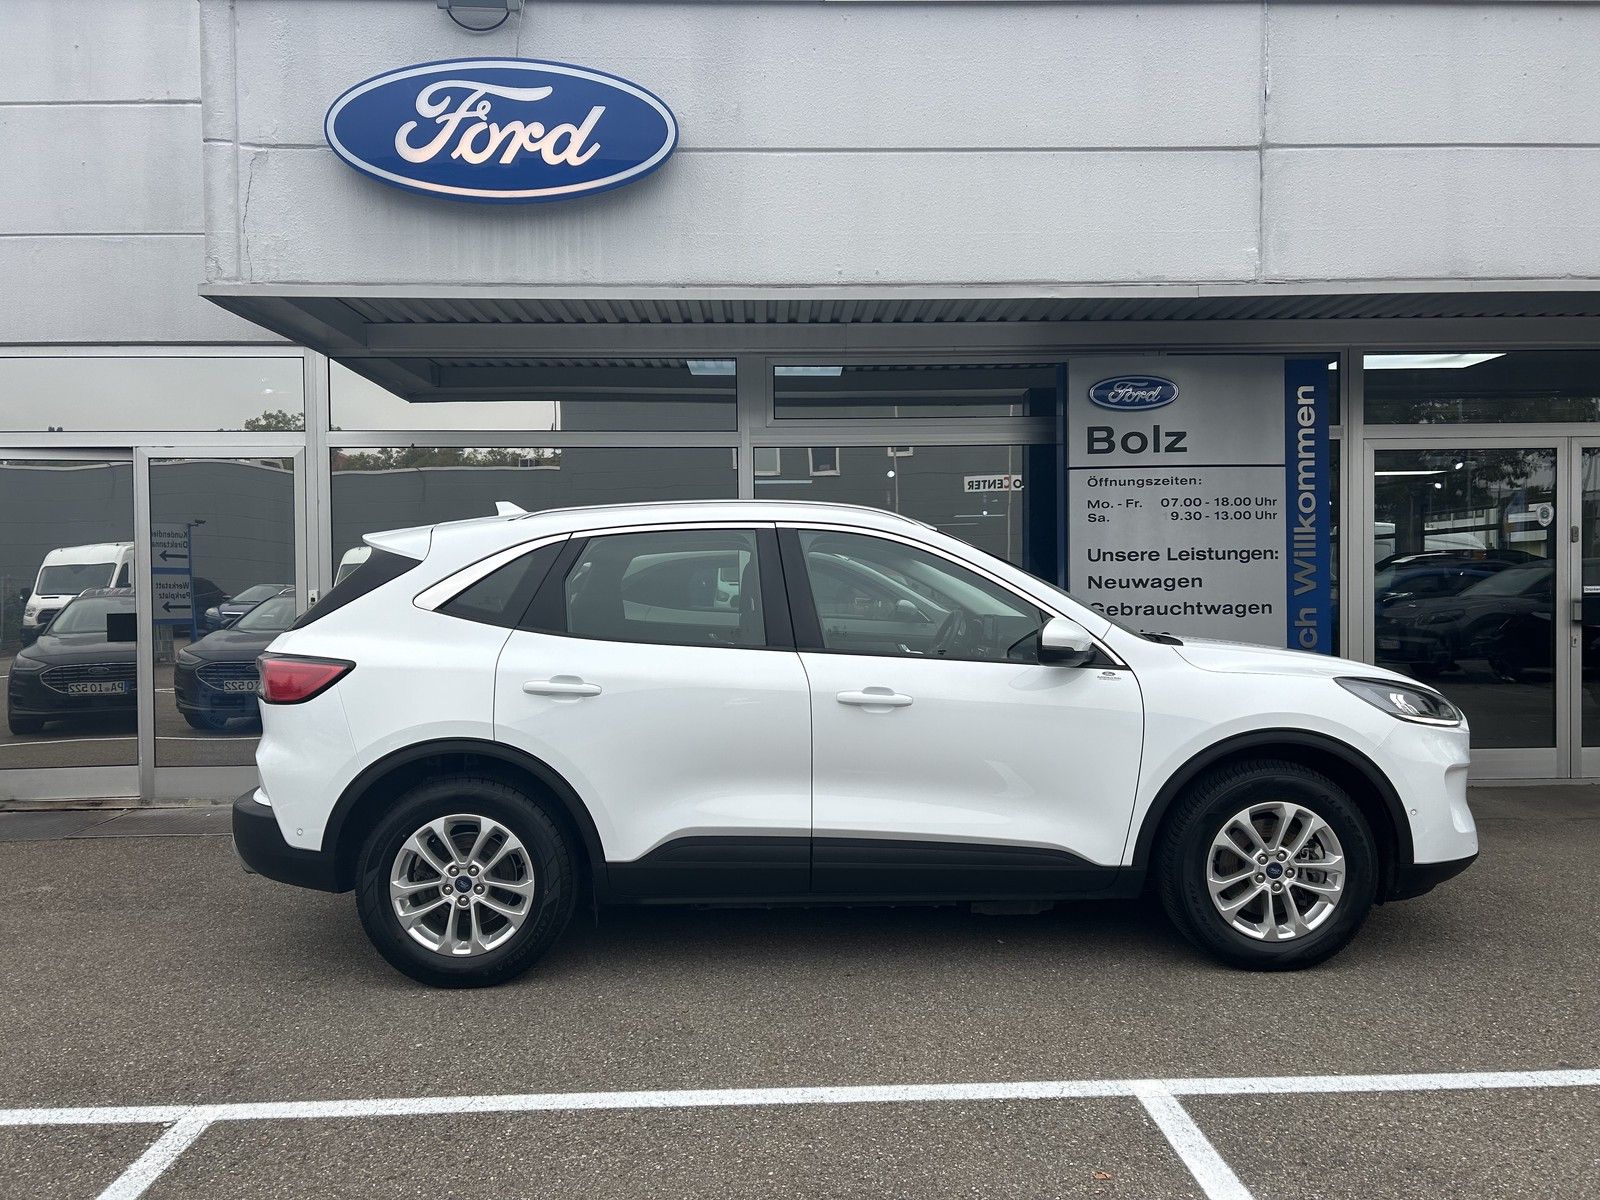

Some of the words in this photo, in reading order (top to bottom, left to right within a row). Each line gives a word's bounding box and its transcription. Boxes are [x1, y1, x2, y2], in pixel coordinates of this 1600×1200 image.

[394, 79, 606, 166] Ford
[1107, 381, 1162, 404] Ford
[1086, 424, 1188, 455] Bolz
[1087, 476, 1202, 489] Öffnungszeiten:
[1293, 384, 1316, 596] Willkommen
[1087, 499, 1114, 509] Mo.
[1125, 498, 1143, 508] Fr.
[1160, 497, 1202, 508] 07.00
[1214, 496, 1252, 507] 18.00
[1255, 496, 1278, 507] Uhr
[1087, 513, 1110, 523] Sa.
[1170, 511, 1202, 521] 9.30
[1214, 511, 1252, 521] 13.00
[1255, 510, 1278, 520] Uhr
[1087, 548, 1160, 563] Unsere
[1167, 547, 1279, 564] Leistungen:
[1087, 576, 1203, 592] Neuwagen
